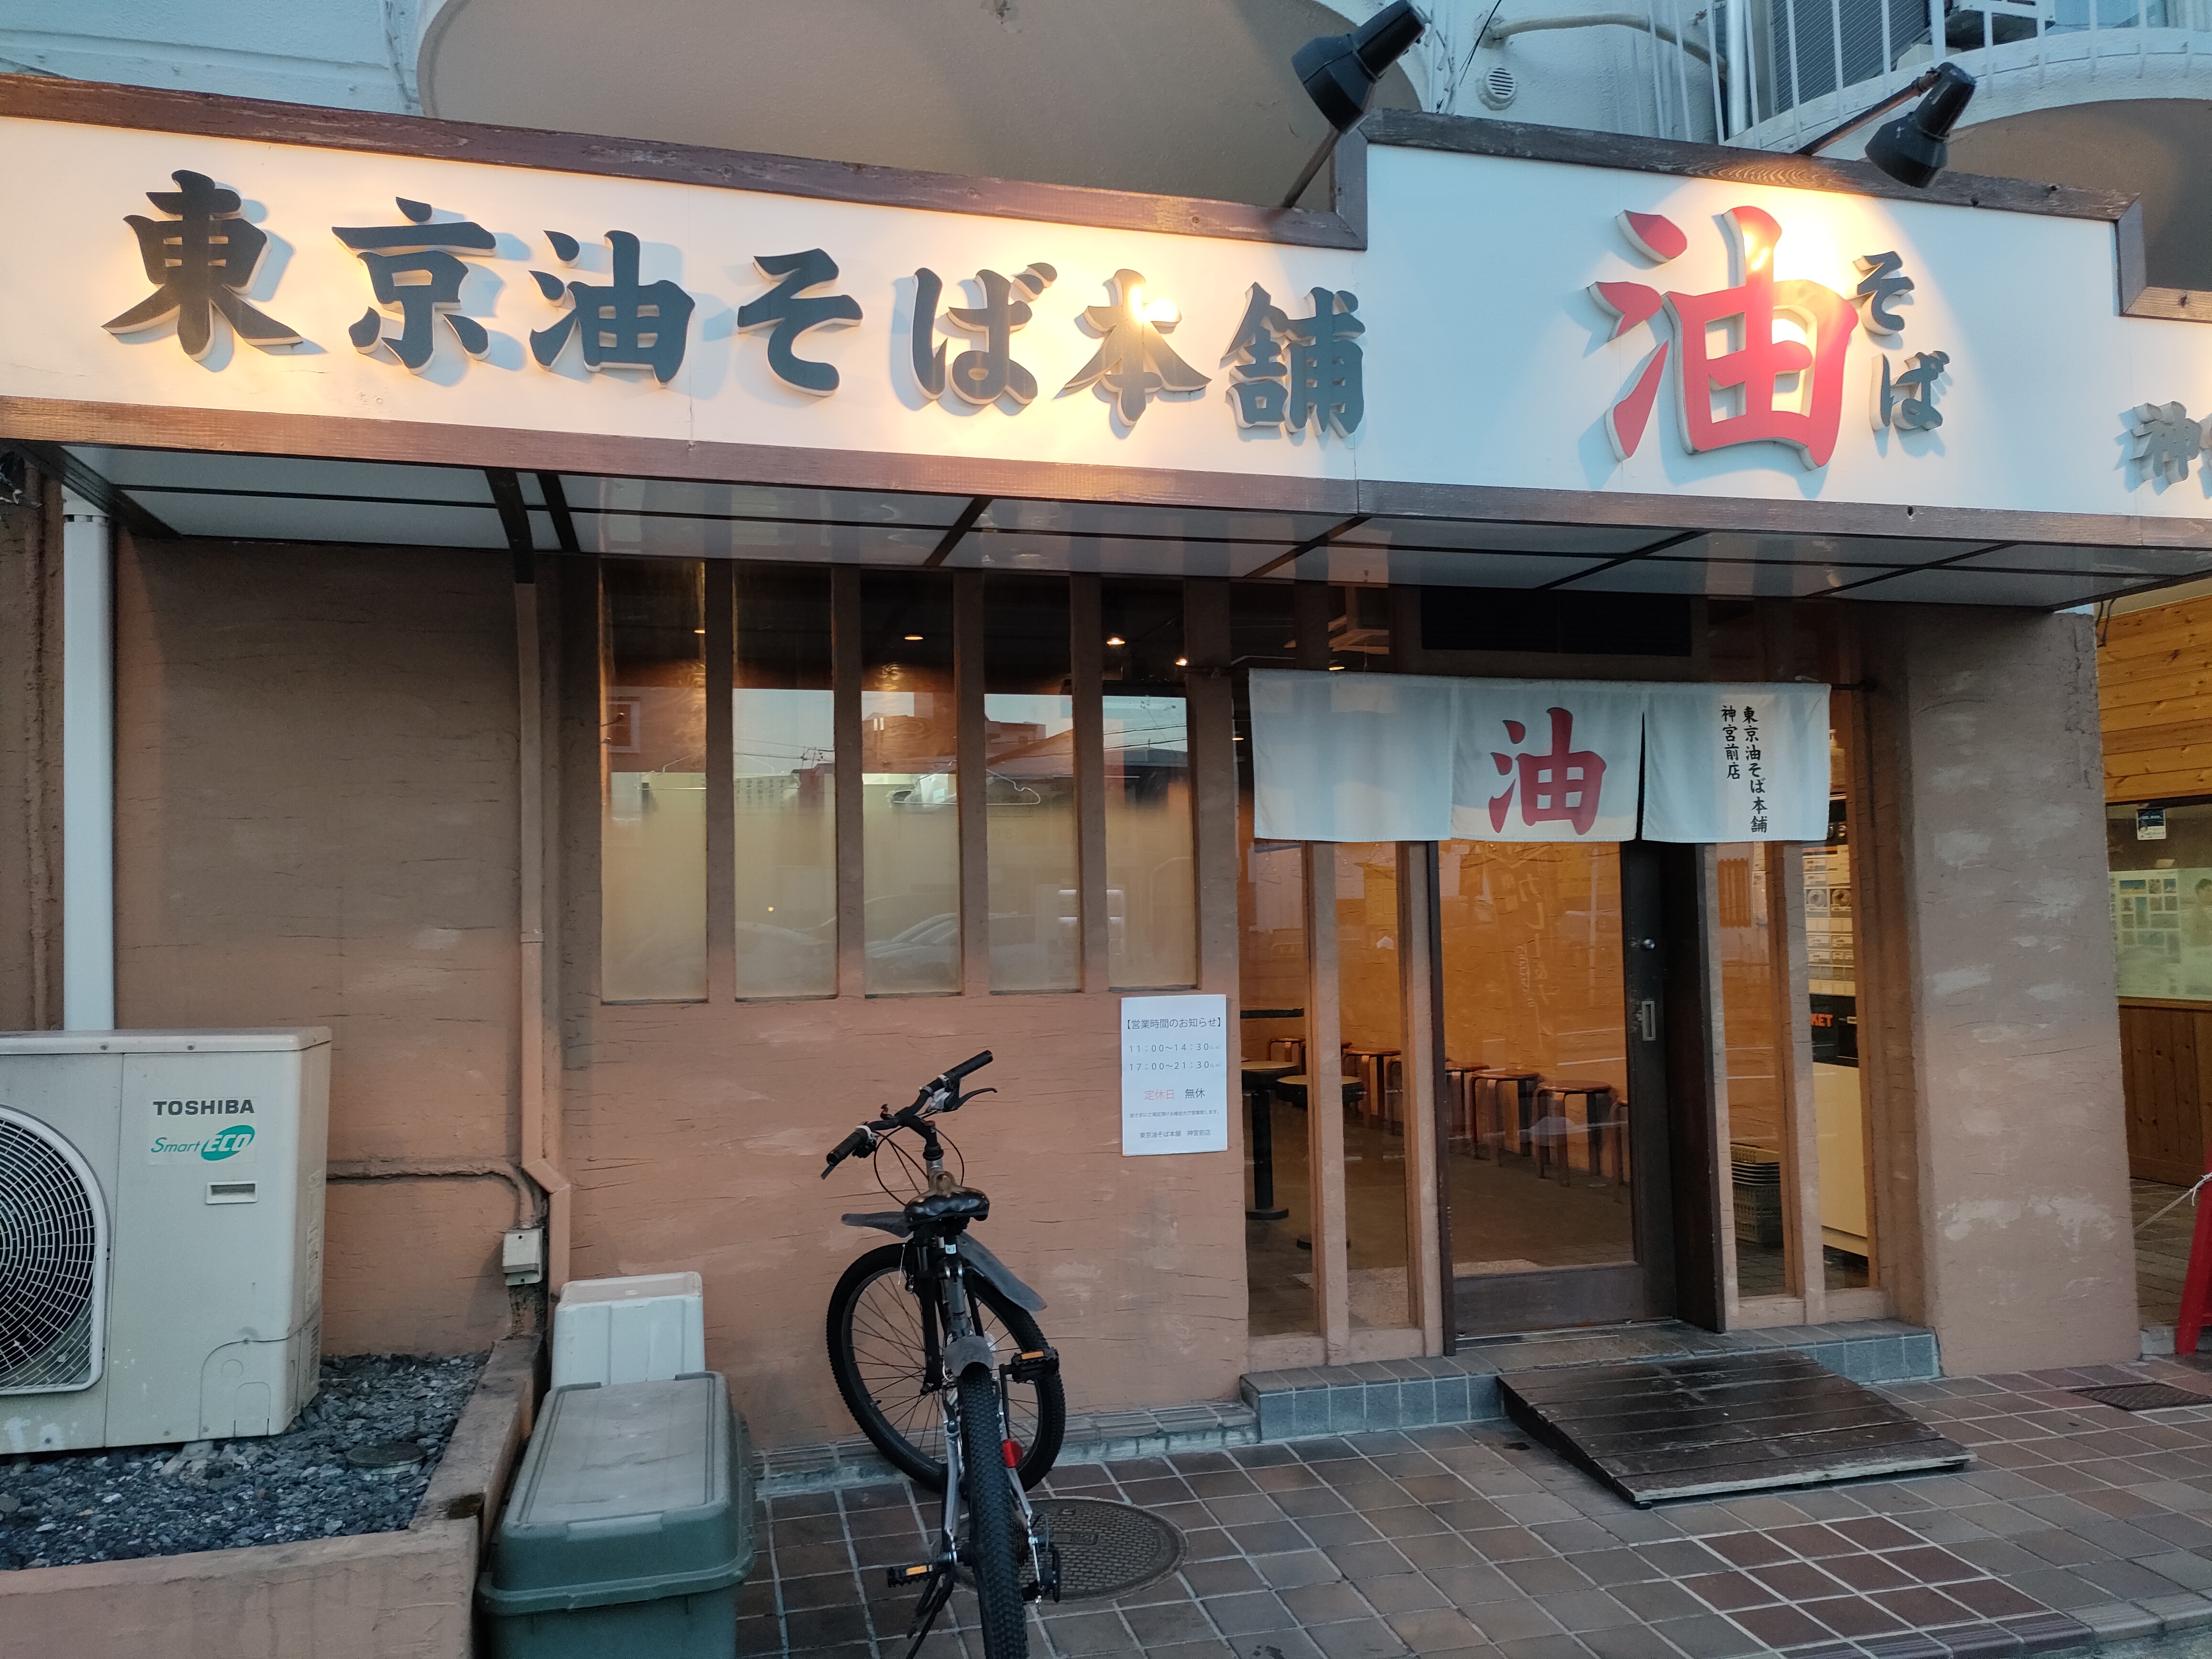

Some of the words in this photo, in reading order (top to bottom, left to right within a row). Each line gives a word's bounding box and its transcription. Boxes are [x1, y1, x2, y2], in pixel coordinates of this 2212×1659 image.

[100, 169, 1366, 437] 東京油そば本舗
[2130, 401, 2212, 485] 神
[1721, 705, 1741, 780] 神宮前店
[1488, 707, 1607, 836] 油
[1742, 706, 1769, 834] 東京油そば本舗
[1127, 1017, 1221, 1030] 【営業時間のお知らせ】
[153, 1099, 255, 1116] TOSHIBA
[1144, 1089, 1174, 1101] 定休日
[1185, 1088, 1206, 1099] 無休
[150, 1137, 201, 1153] Smart
[1139, 1130, 1182, 1139] 東京油そば本舗
